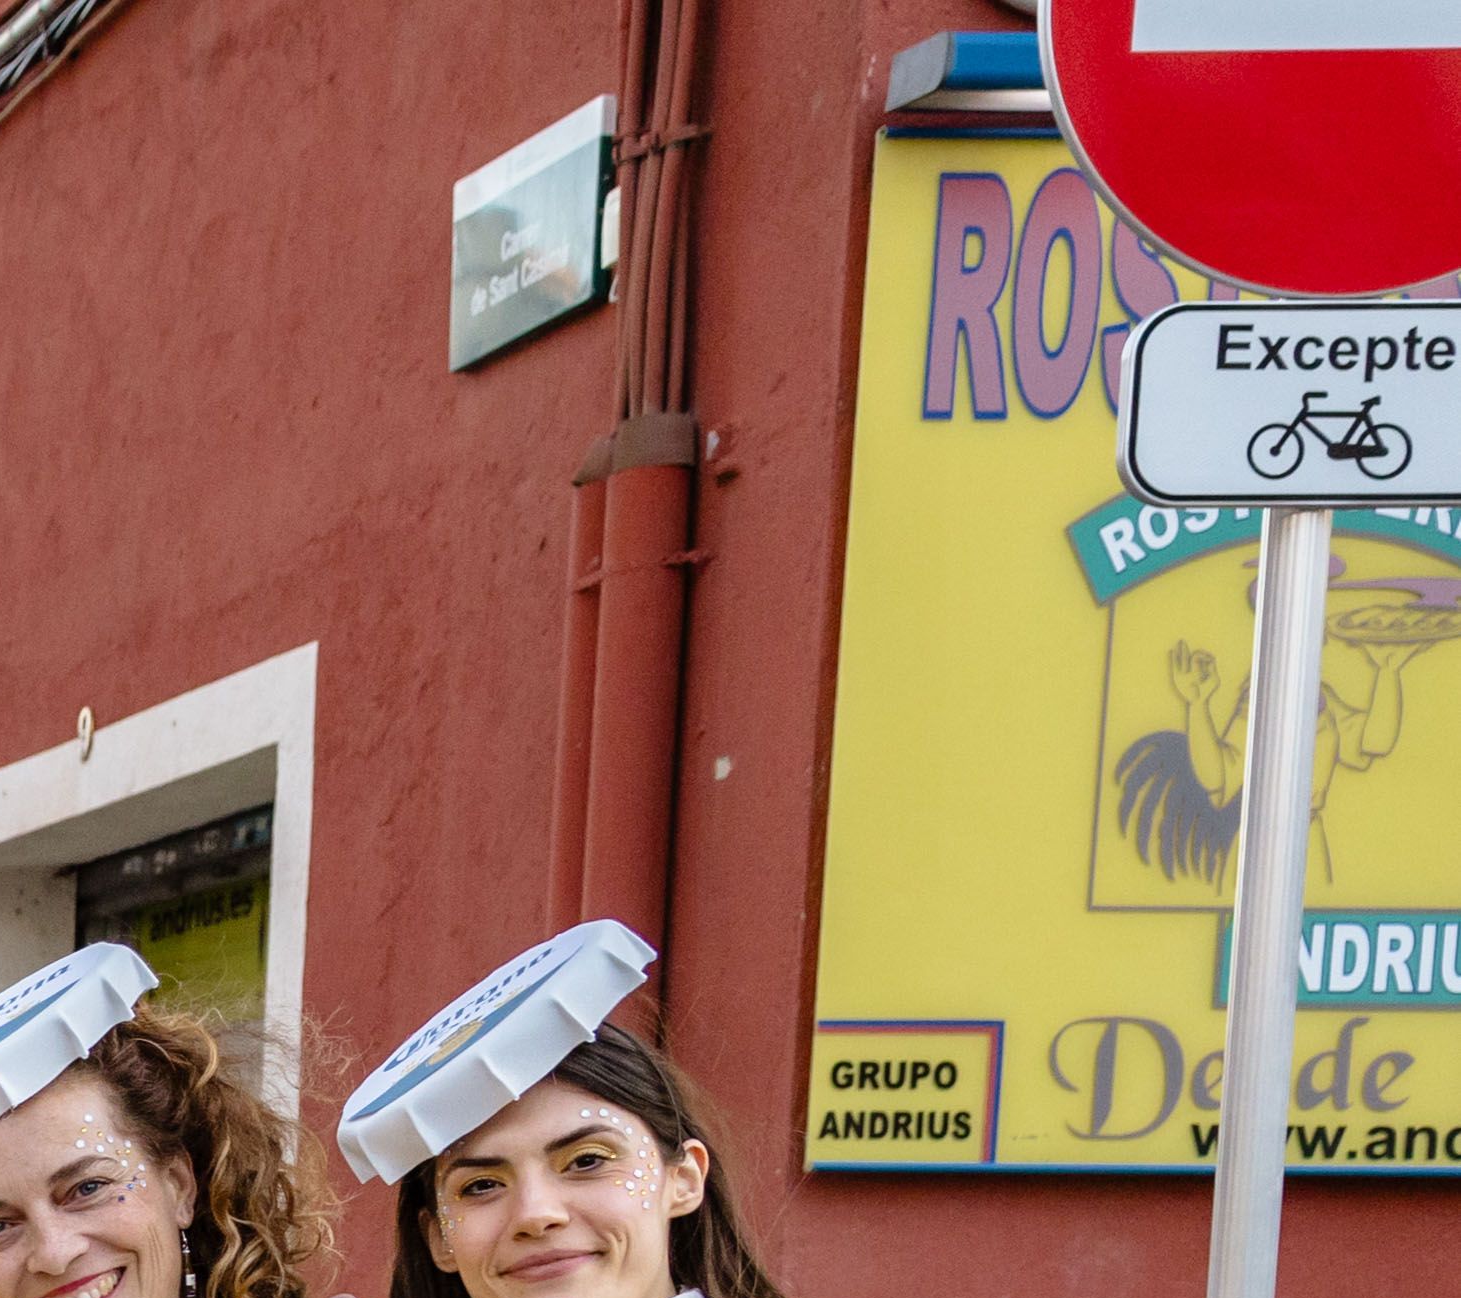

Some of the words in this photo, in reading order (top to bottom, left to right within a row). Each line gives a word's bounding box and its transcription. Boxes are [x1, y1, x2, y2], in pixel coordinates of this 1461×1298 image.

[1216, 324, 1457, 382] Excepte
[830, 1061, 958, 1091] GRUPO
[1049, 1016, 1415, 1142] Dede
[819, 1111, 972, 1141] ANDRIUS
